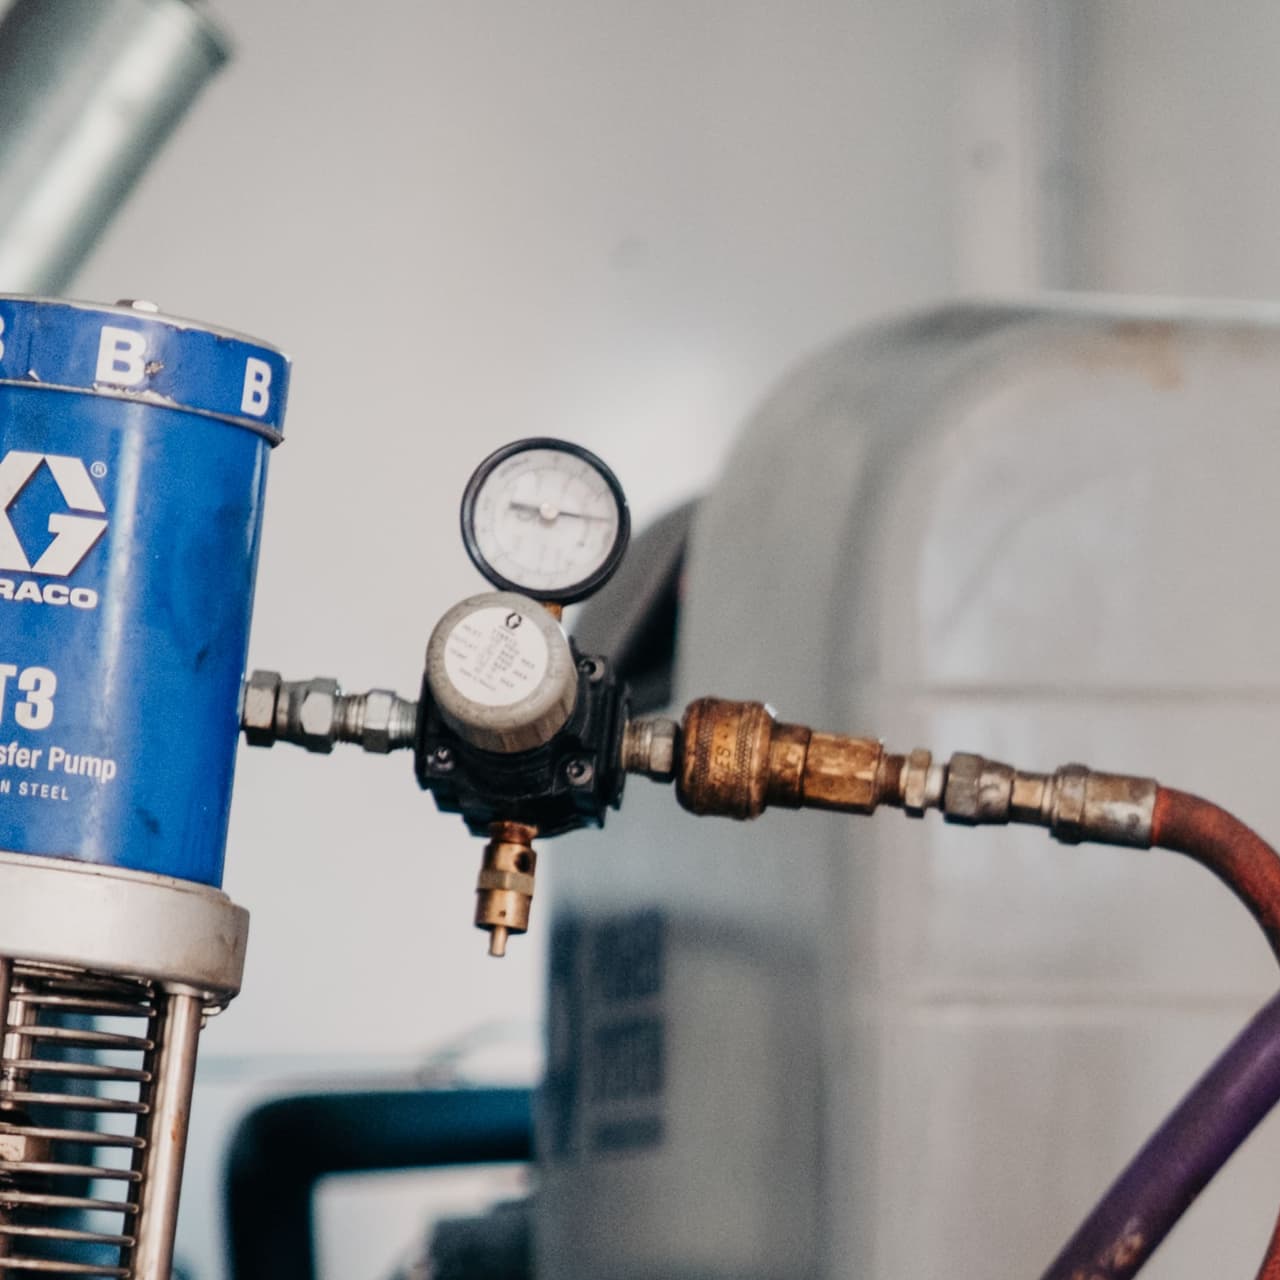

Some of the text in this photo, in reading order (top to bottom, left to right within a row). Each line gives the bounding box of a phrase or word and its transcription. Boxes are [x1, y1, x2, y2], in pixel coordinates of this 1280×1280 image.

[95, 326, 272, 416] B B
[0, 578, 98, 610] RACO
[48, 746, 117, 784] Pump
[19, 781, 69, 801] STEEL
